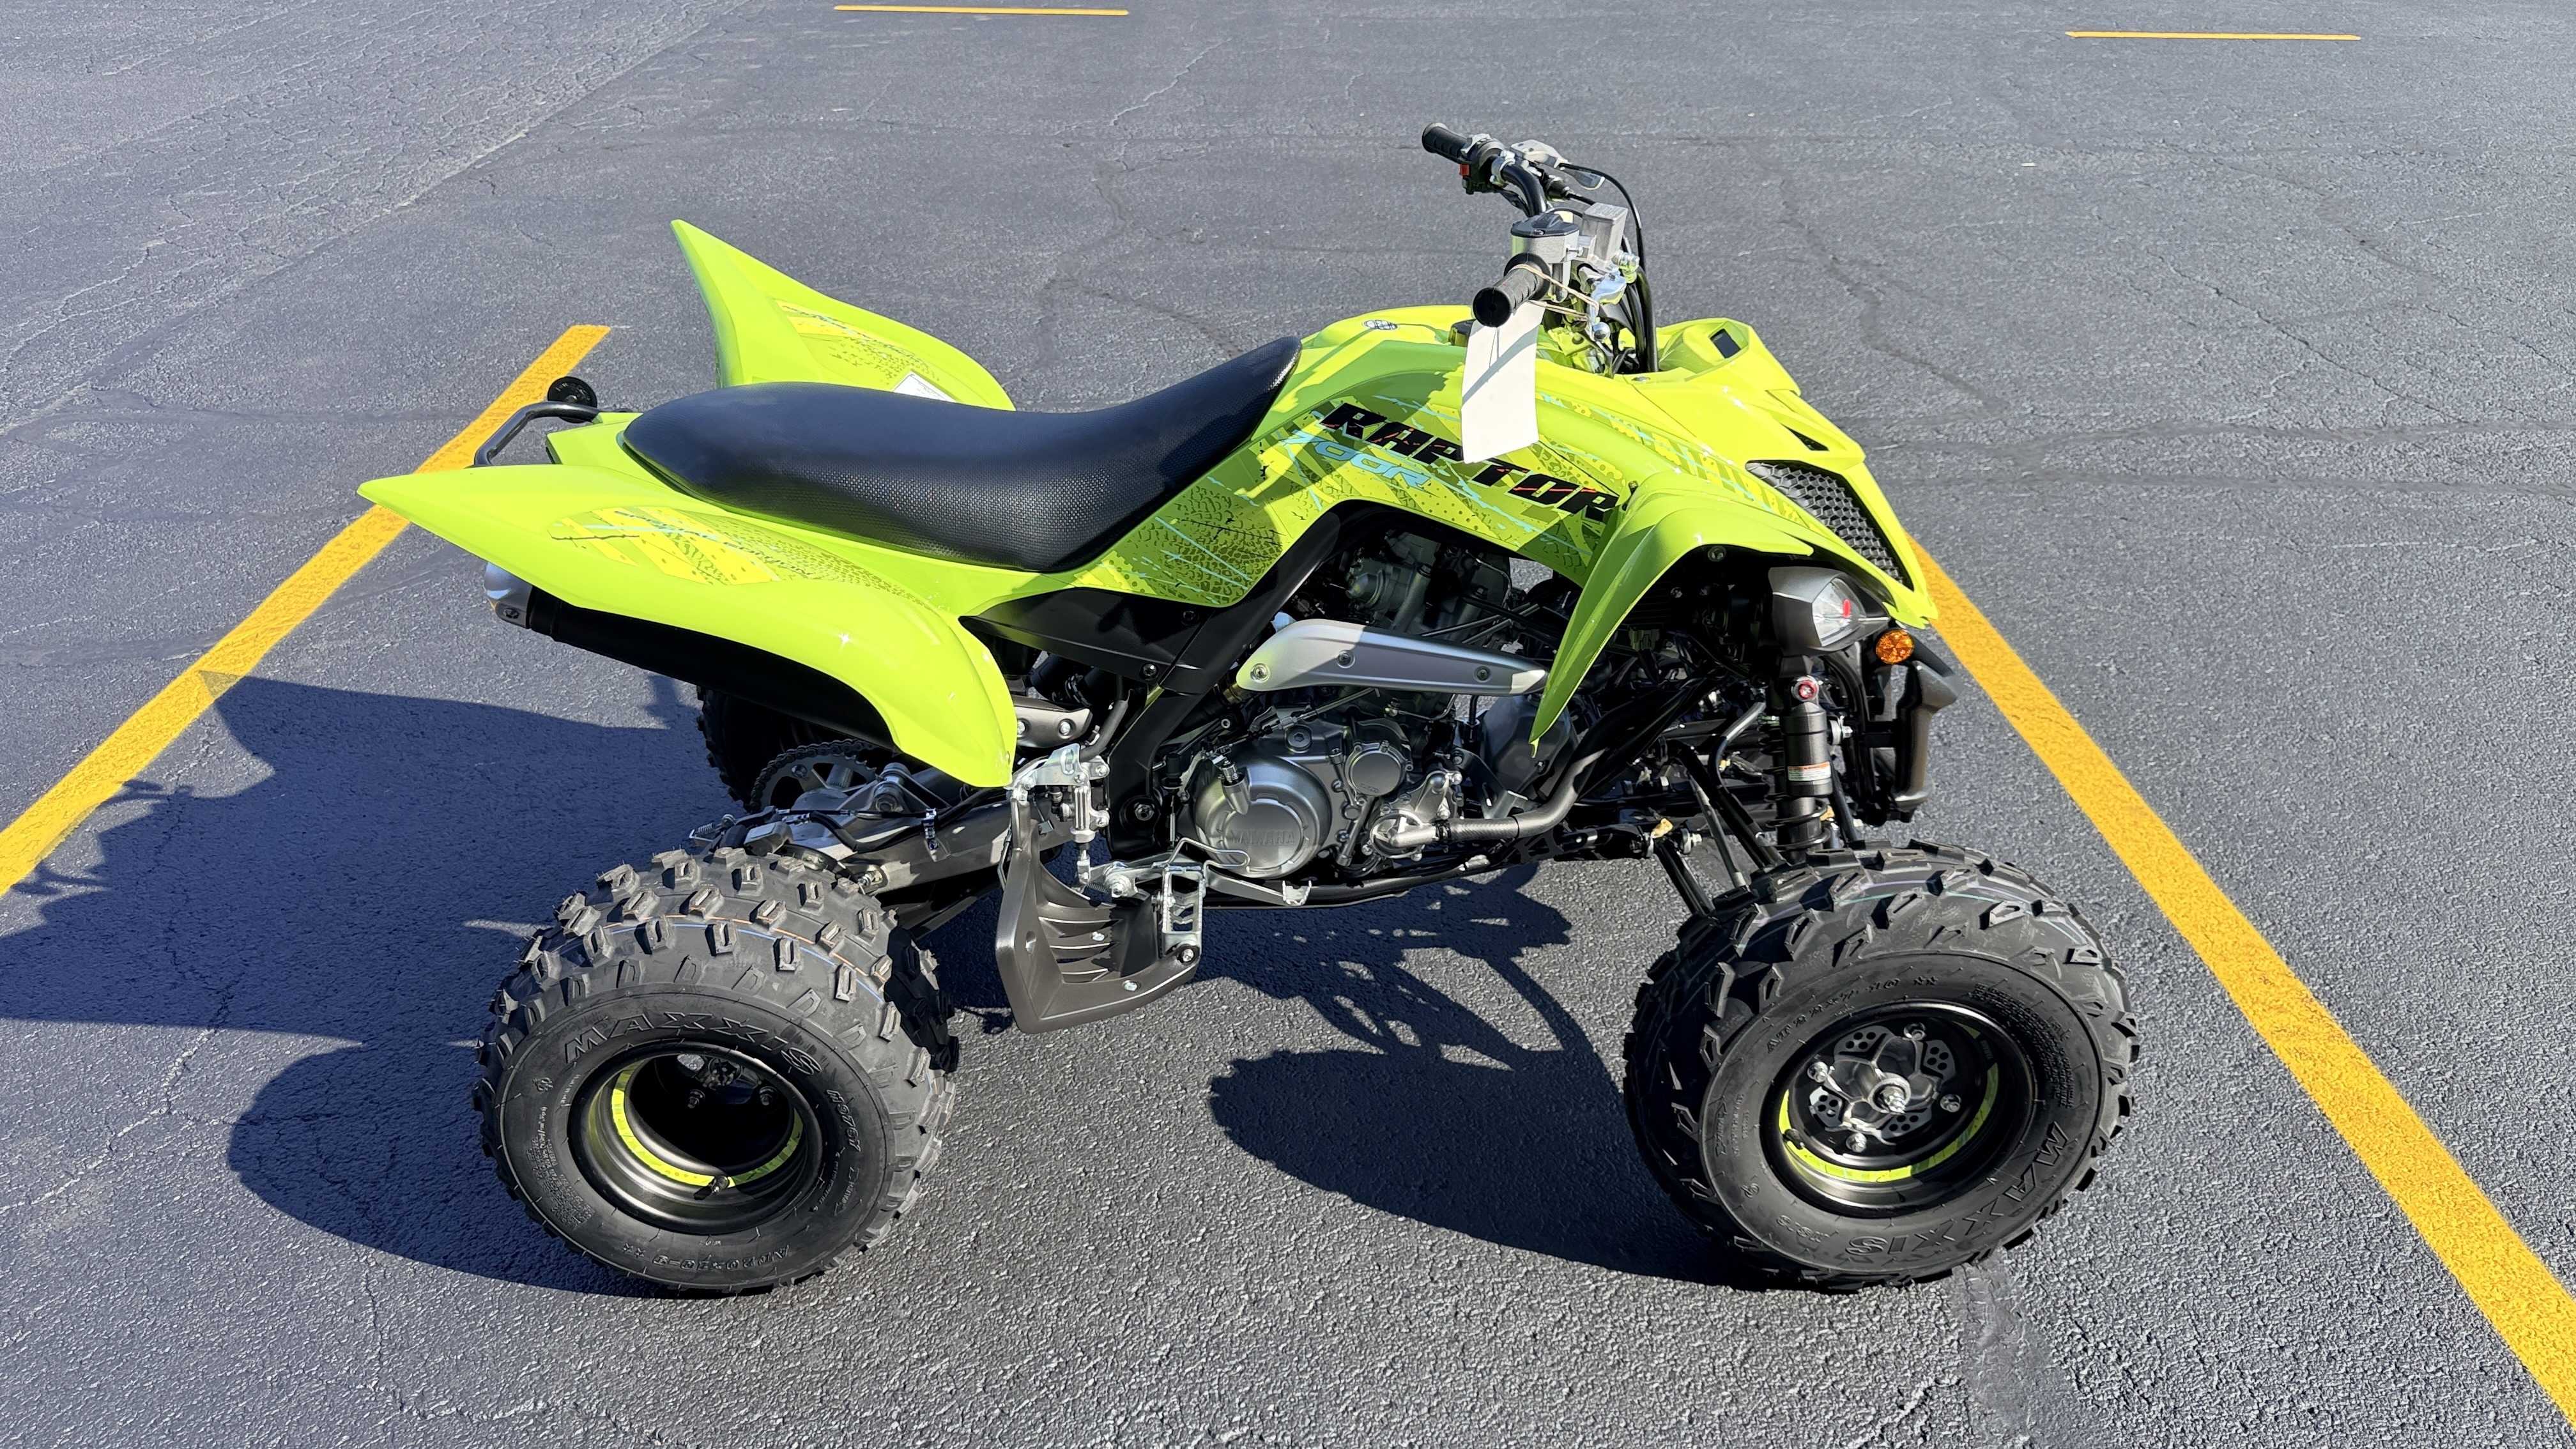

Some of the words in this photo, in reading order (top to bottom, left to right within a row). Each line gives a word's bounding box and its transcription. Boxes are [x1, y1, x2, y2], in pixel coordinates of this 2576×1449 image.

[1230, 830, 1296, 845] YAMAHA
[565, 1011, 823, 1076] MAXXIS
[1845, 1121, 2069, 1256] MAXXIS
